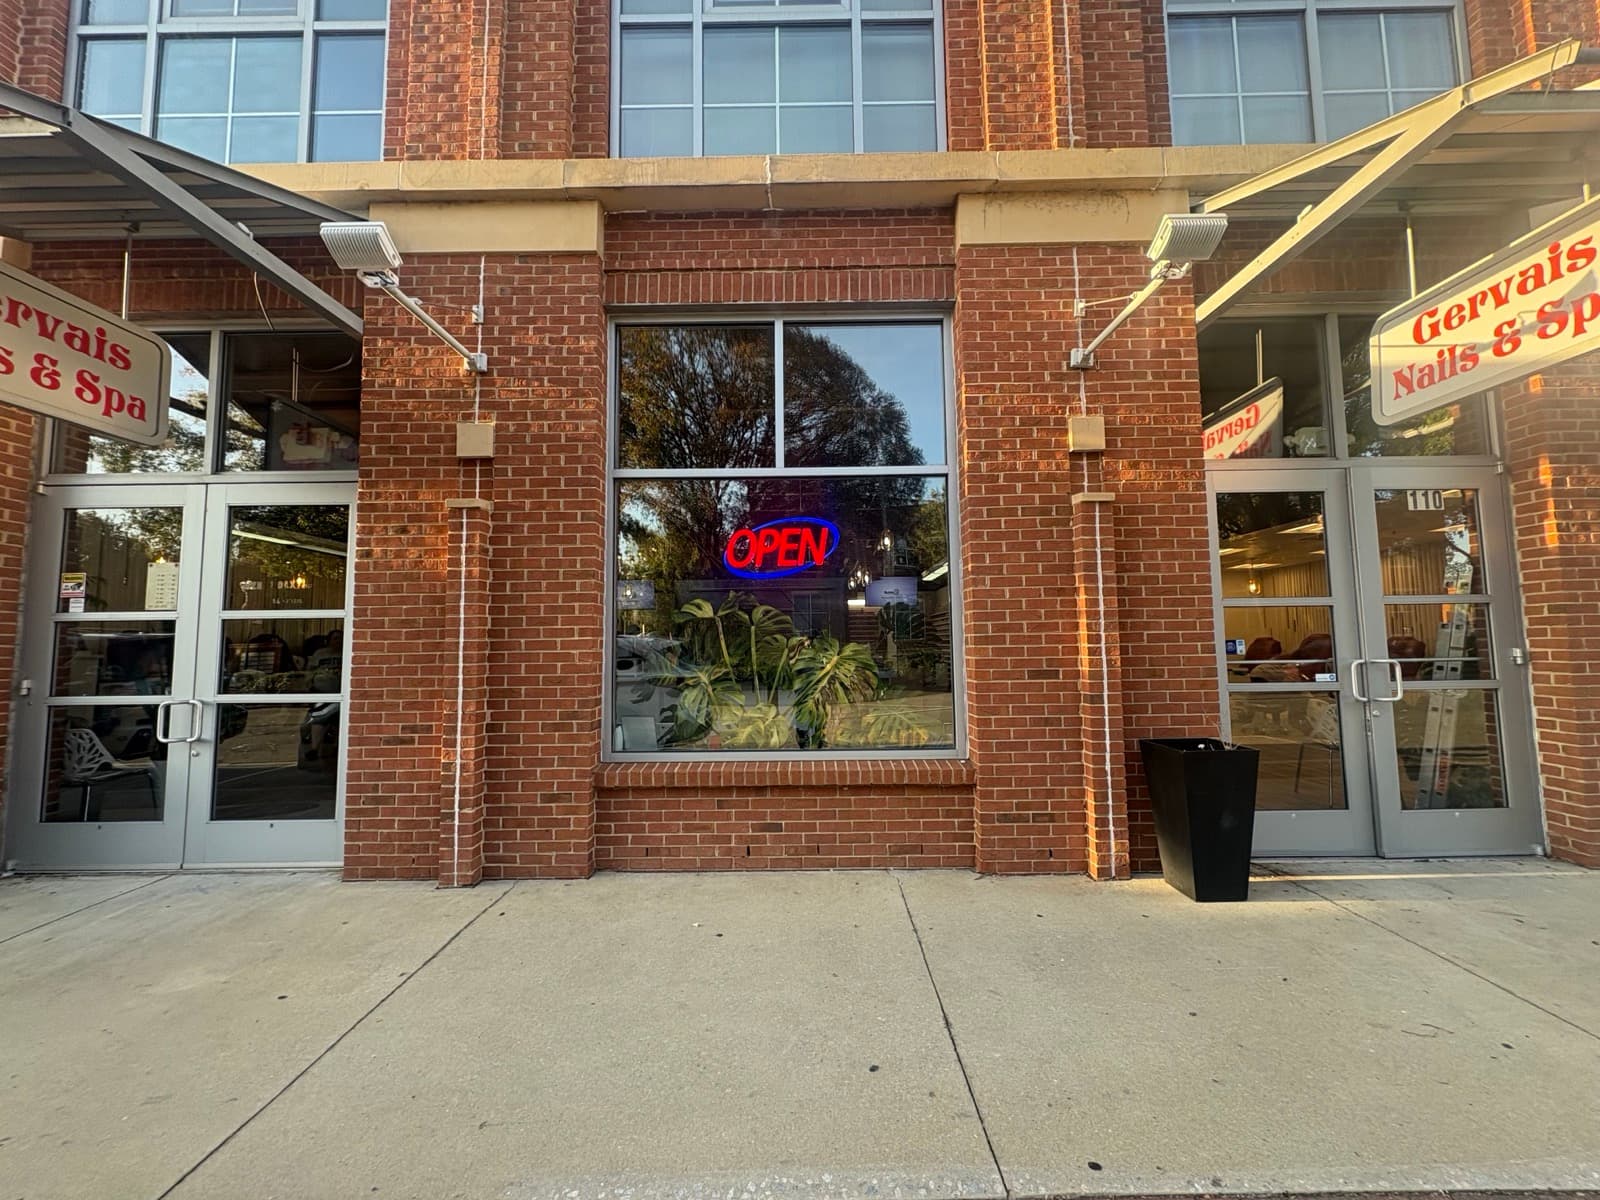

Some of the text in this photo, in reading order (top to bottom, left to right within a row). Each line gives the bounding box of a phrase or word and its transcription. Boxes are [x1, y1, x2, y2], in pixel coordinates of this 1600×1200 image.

[1412, 235, 1597, 345] Gervais
[0, 296, 132, 371] rvais
[1392, 344, 1480, 400] Nails
[1492, 318, 1522, 358] &
[30, 353, 62, 390] &
[74, 369, 147, 422] Spa
[1409, 490, 1443, 509] 110
[726, 527, 829, 569] OPEN
